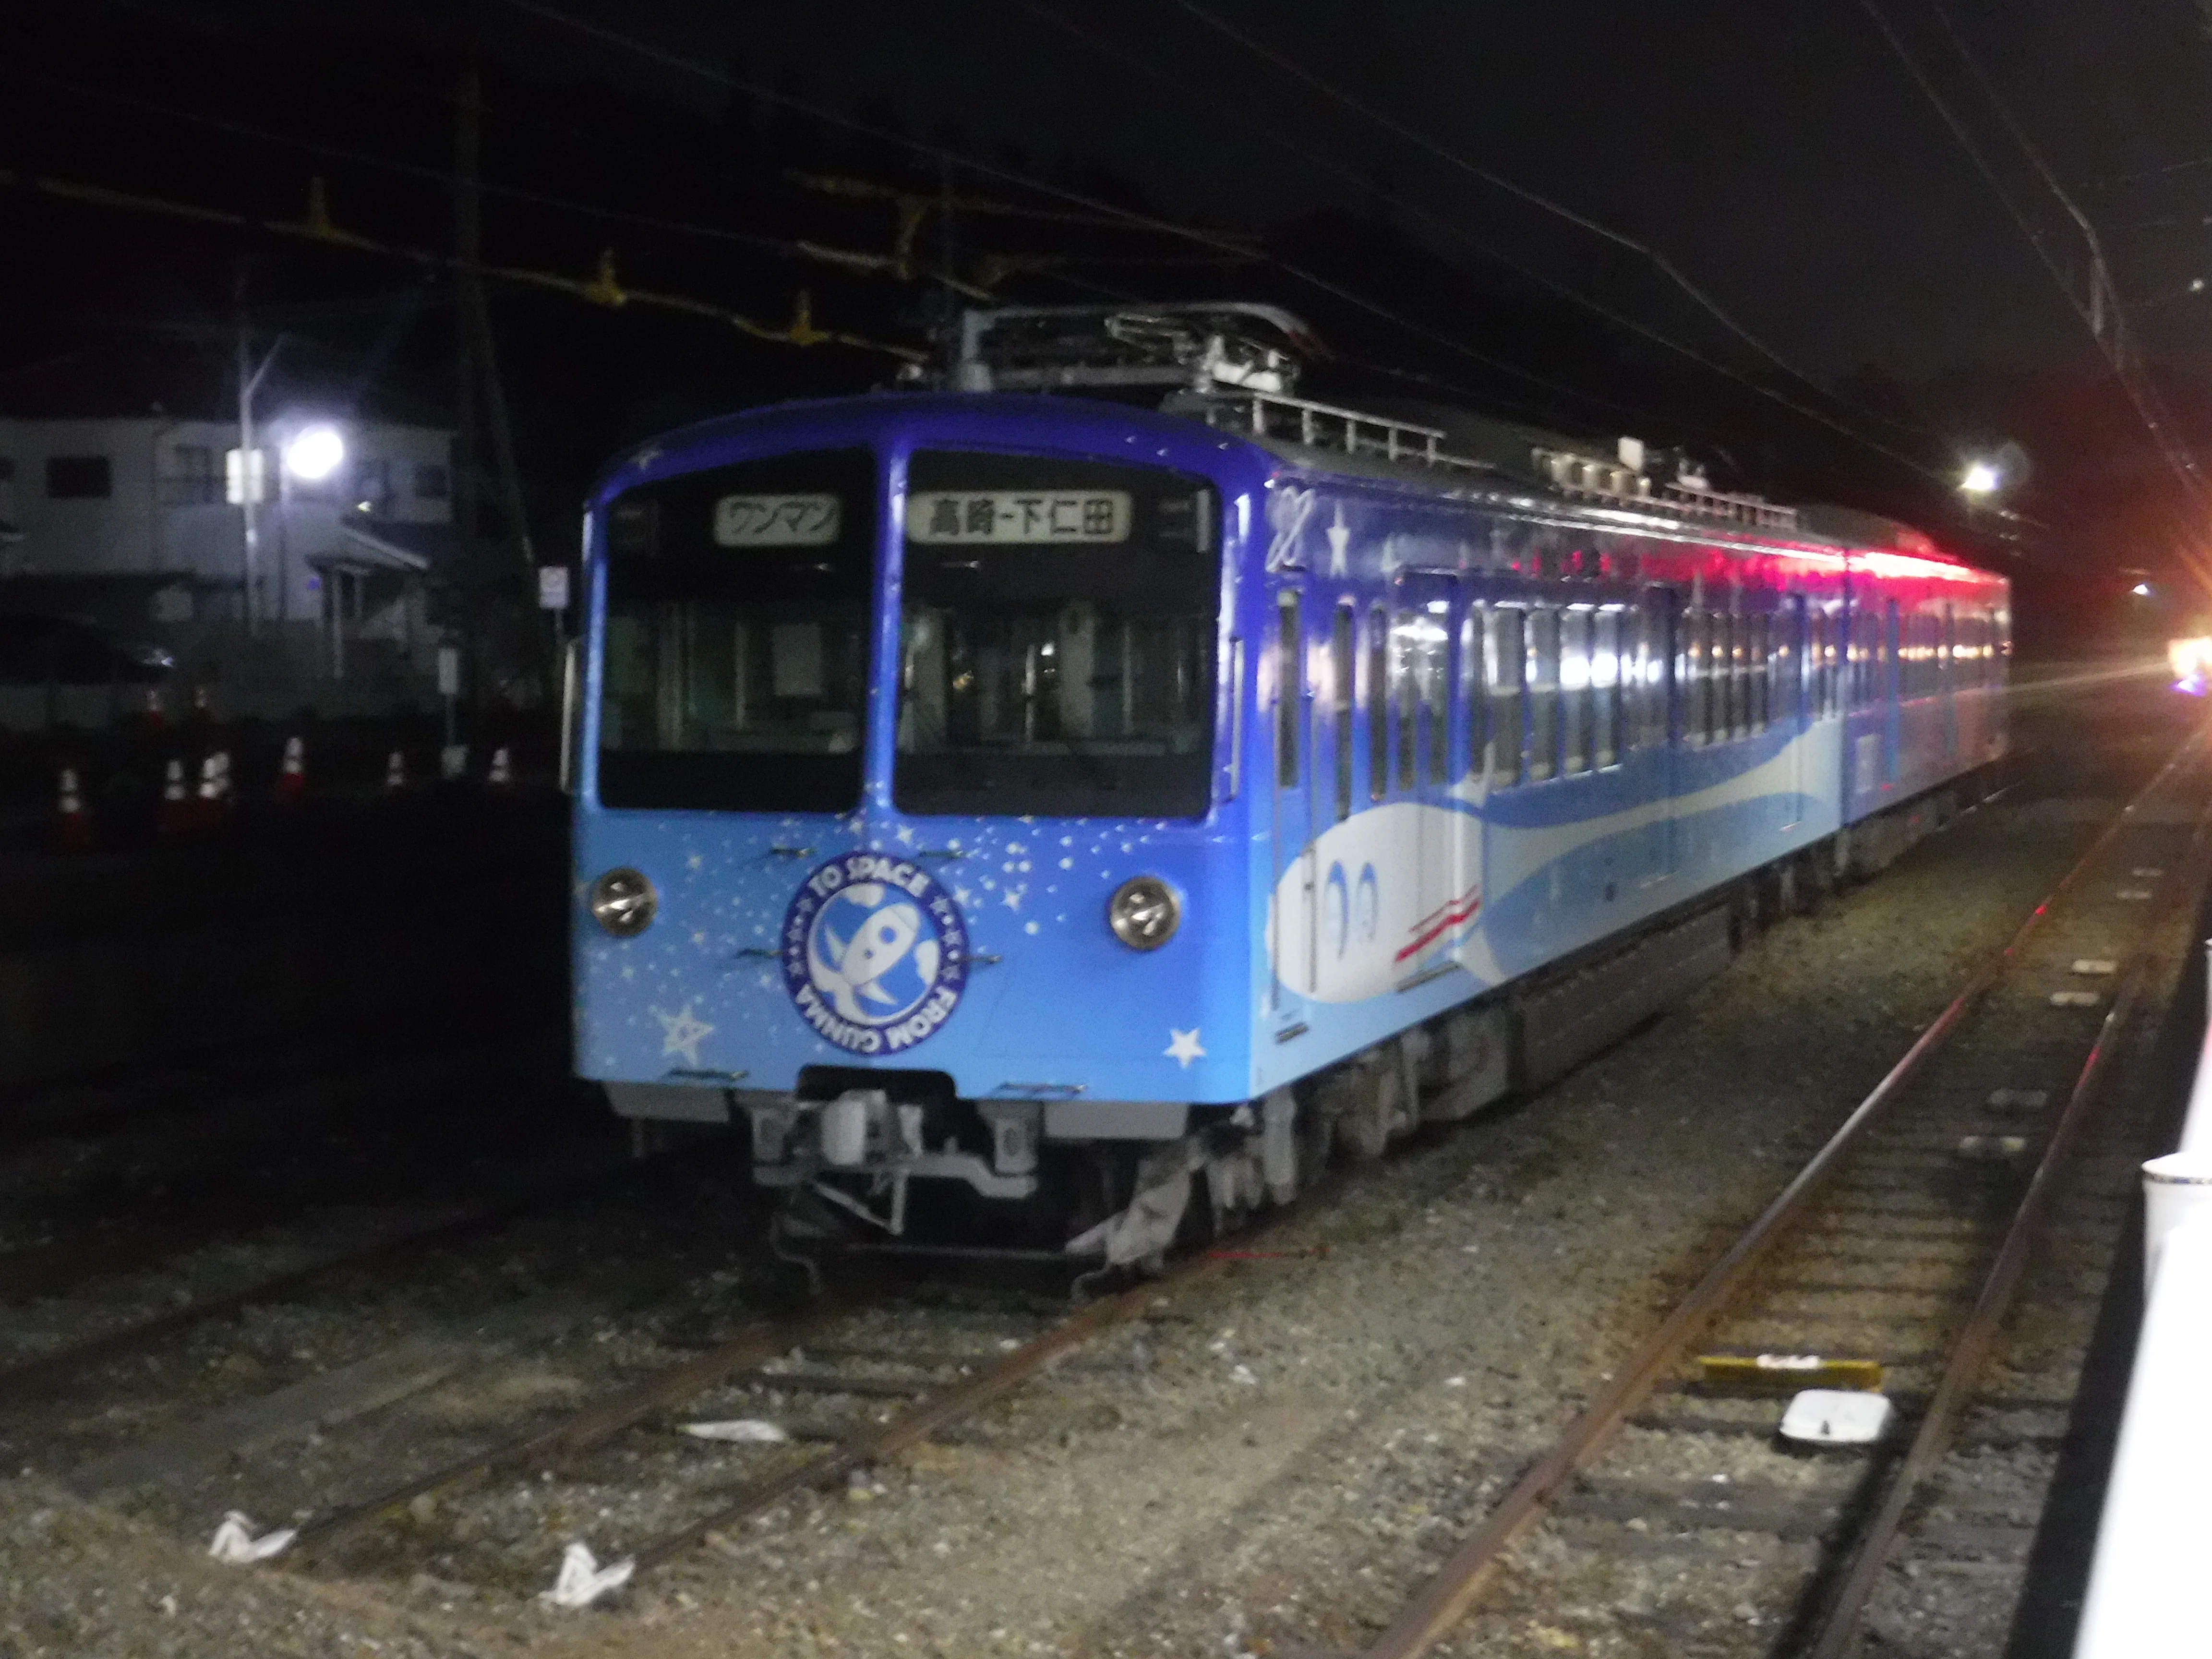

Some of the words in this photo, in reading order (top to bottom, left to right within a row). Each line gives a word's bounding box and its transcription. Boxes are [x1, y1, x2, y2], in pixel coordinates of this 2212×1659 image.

[729, 500, 836, 534] ワンマン
[809, 864, 843, 897] TO
[846, 855, 932, 898] SPACE
[796, 984, 882, 1053] GUNMA
[886, 986, 958, 1050] FROM
